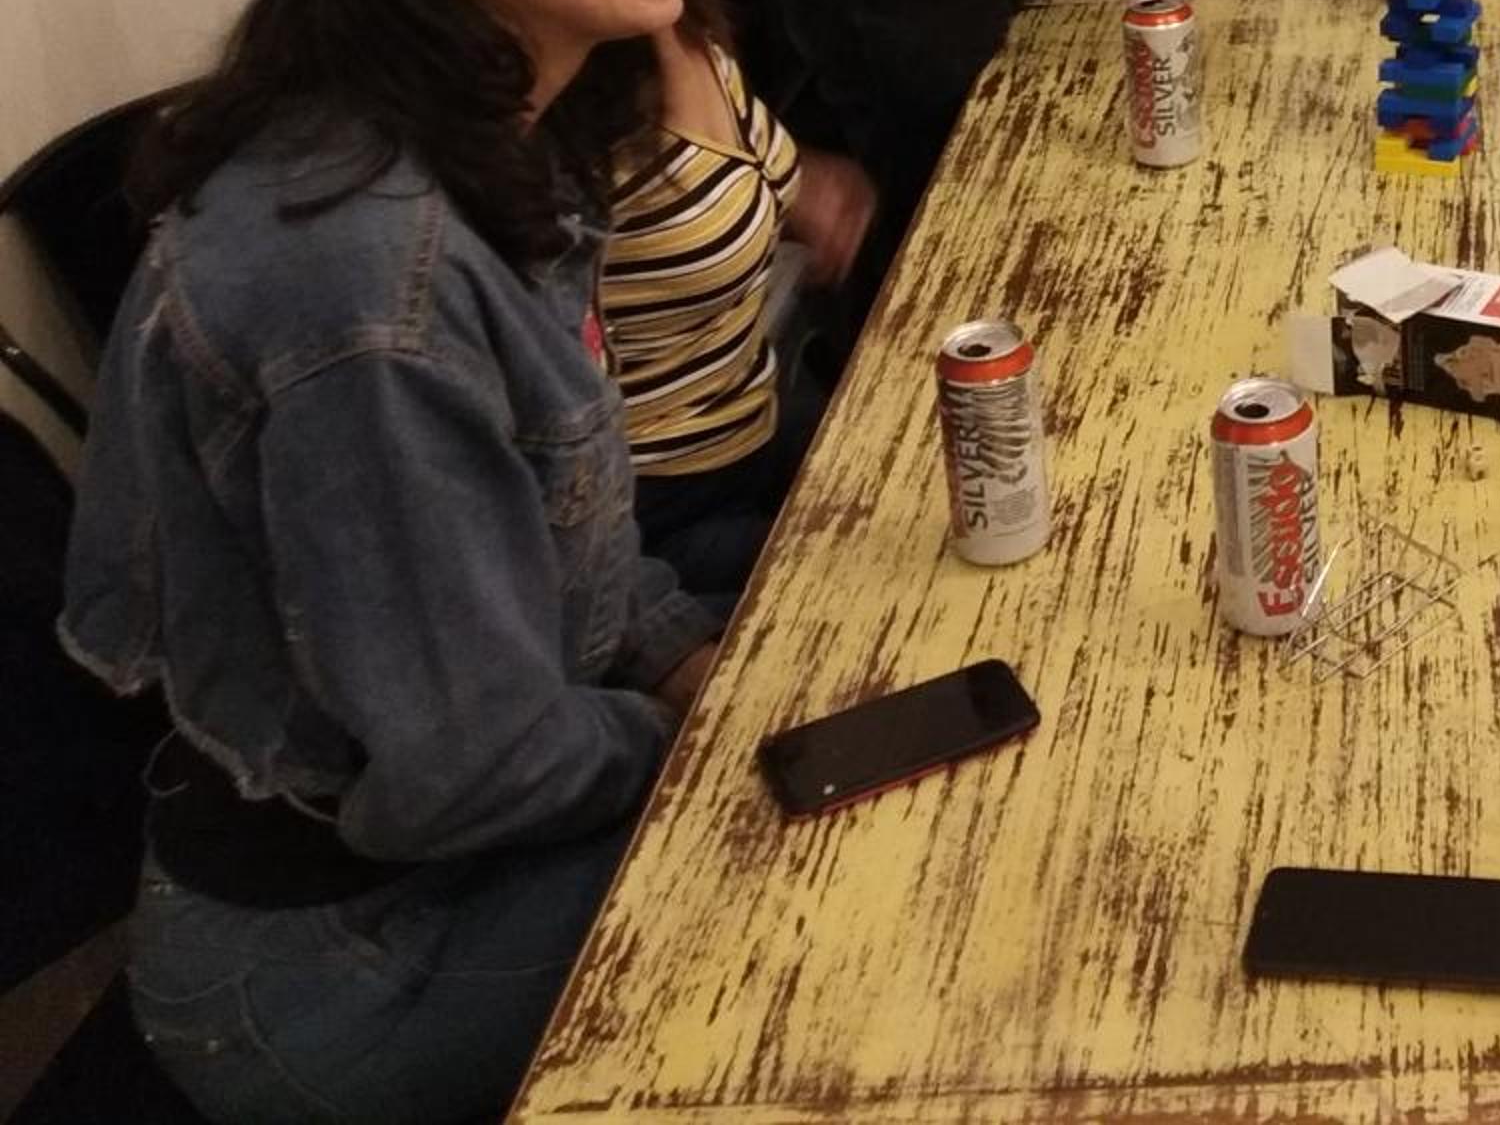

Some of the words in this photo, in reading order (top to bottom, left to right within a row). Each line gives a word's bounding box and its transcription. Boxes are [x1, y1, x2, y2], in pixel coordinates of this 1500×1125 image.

[1154, 57, 1176, 137] SILVER
[957, 425, 989, 529] SILVER
[1258, 462, 1305, 616] Escudo
